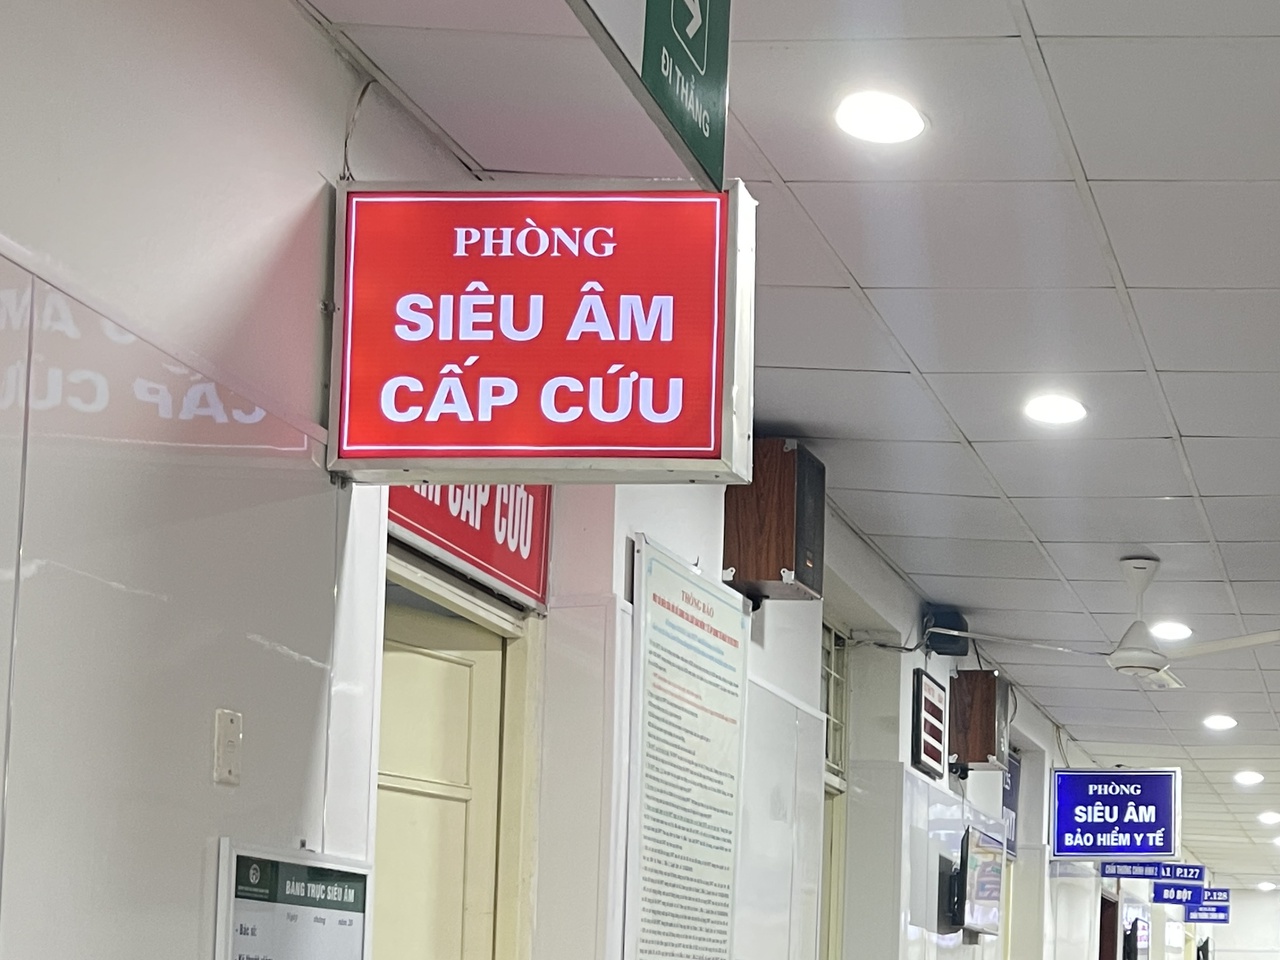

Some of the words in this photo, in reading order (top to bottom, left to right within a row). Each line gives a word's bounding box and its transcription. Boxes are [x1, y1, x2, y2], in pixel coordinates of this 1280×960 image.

[661, 46, 673, 85] ĐI
[452, 217, 618, 258] PHÒNG
[394, 281, 544, 342] SIÊU
[565, 281, 674, 342] ÂM
[380, 357, 519, 424] CẤP
[539, 366, 684, 424] CỨU
[1088, 782, 1142, 795] PHÒNG
[1074, 801, 1119, 823] SIÊU
[1123, 801, 1156, 823] ÂM
[1064, 828, 1094, 846] BẢO
[1097, 826, 1131, 846] HIỂM
[1134, 833, 1144, 846] Y
[1146, 827, 1165, 846] TẾ
[1175, 867, 1200, 878] P.127
[285, 877, 305, 897] BẢNG
[307, 883, 326, 902] TRỰC
[326, 883, 343, 901] SIÊU
[343, 885, 355, 903] ÂM
[1204, 891, 1228, 900] P.128
